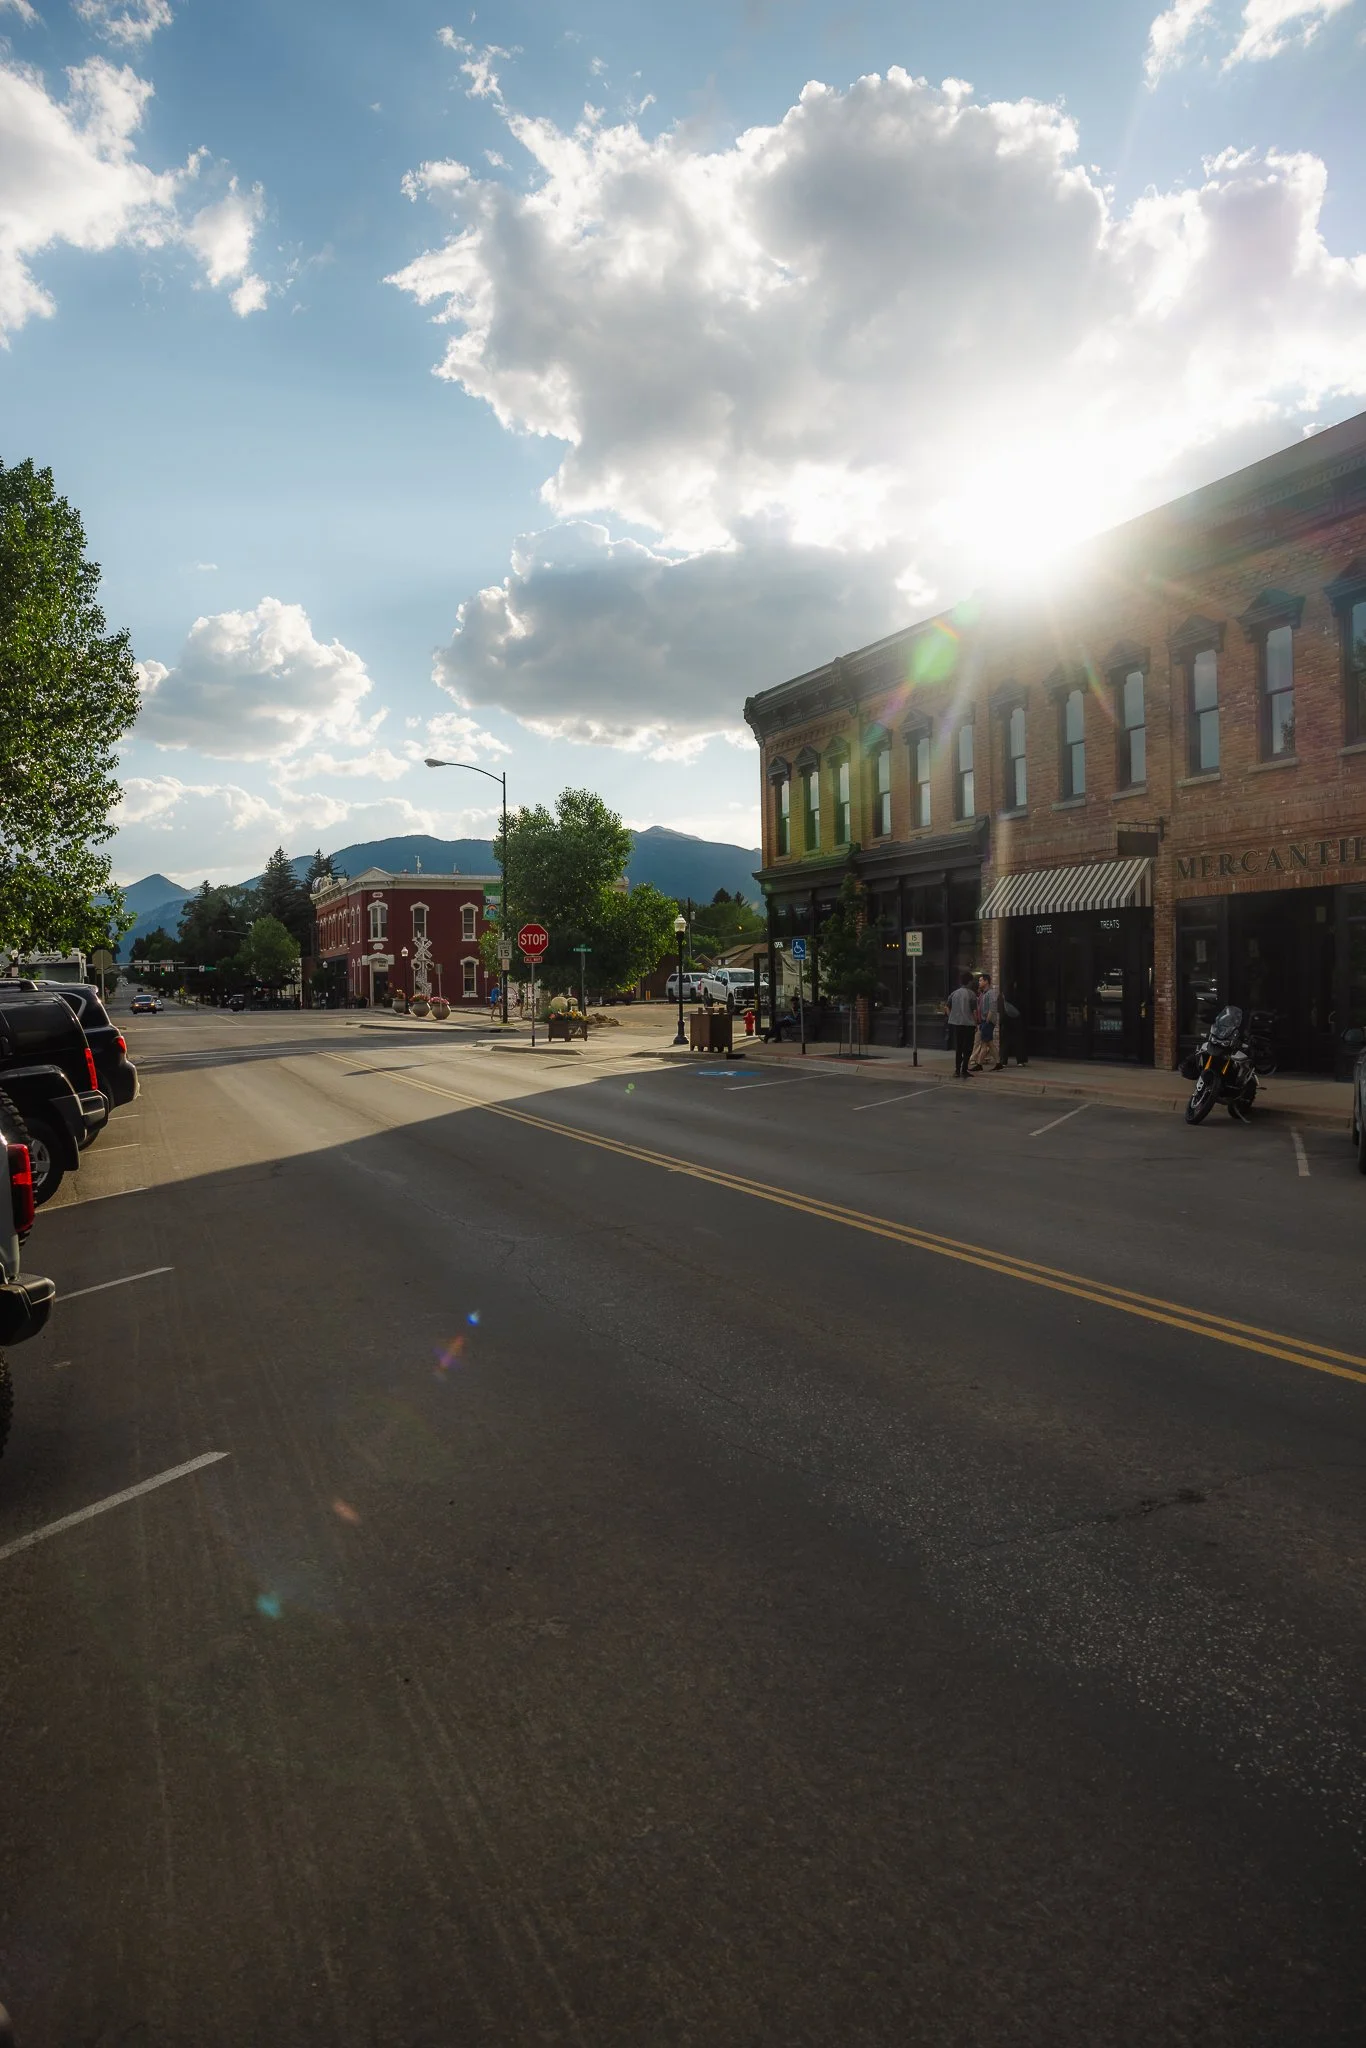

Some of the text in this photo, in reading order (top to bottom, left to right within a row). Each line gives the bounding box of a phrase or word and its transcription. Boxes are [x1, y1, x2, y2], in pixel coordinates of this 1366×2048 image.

[1035, 924, 1053, 935] COFFEE
[1100, 919, 1120, 930] TREATS
[520, 933, 546, 946] STOP
[911, 934, 918, 942] 15
[500, 949, 510, 957] 15
